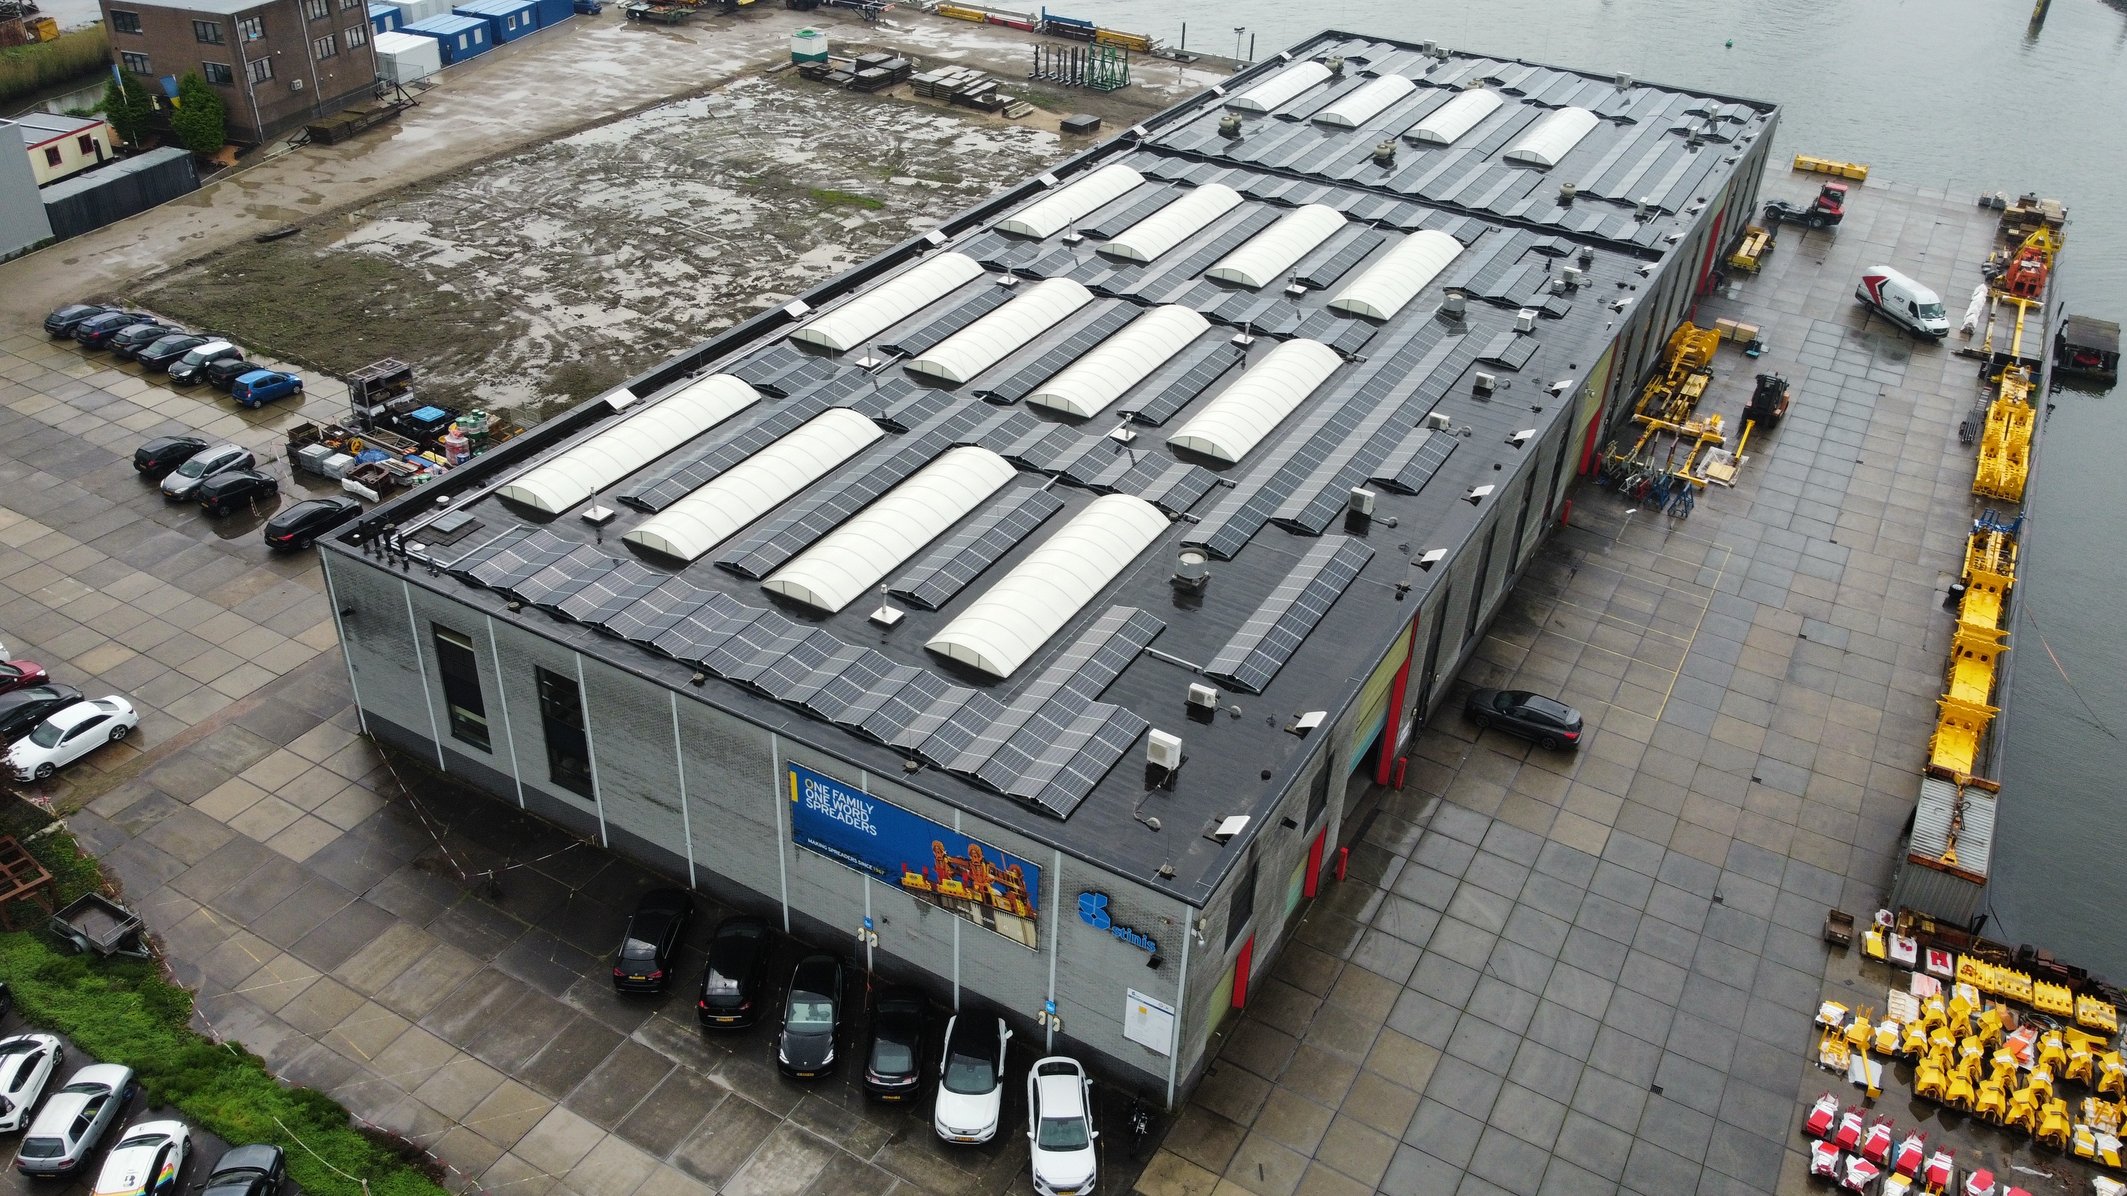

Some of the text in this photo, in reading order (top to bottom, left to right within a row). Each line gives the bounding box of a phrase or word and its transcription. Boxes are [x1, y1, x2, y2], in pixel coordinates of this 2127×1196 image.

[804, 778, 874, 815] ONE FAMILY
[805, 788, 869, 822] ONE WORD
[805, 798, 878, 836] SPREADERS
[807, 837, 828, 850] MAKING
[827, 846, 858, 864] SPREADERS
[857, 859, 873, 870] SINCE
